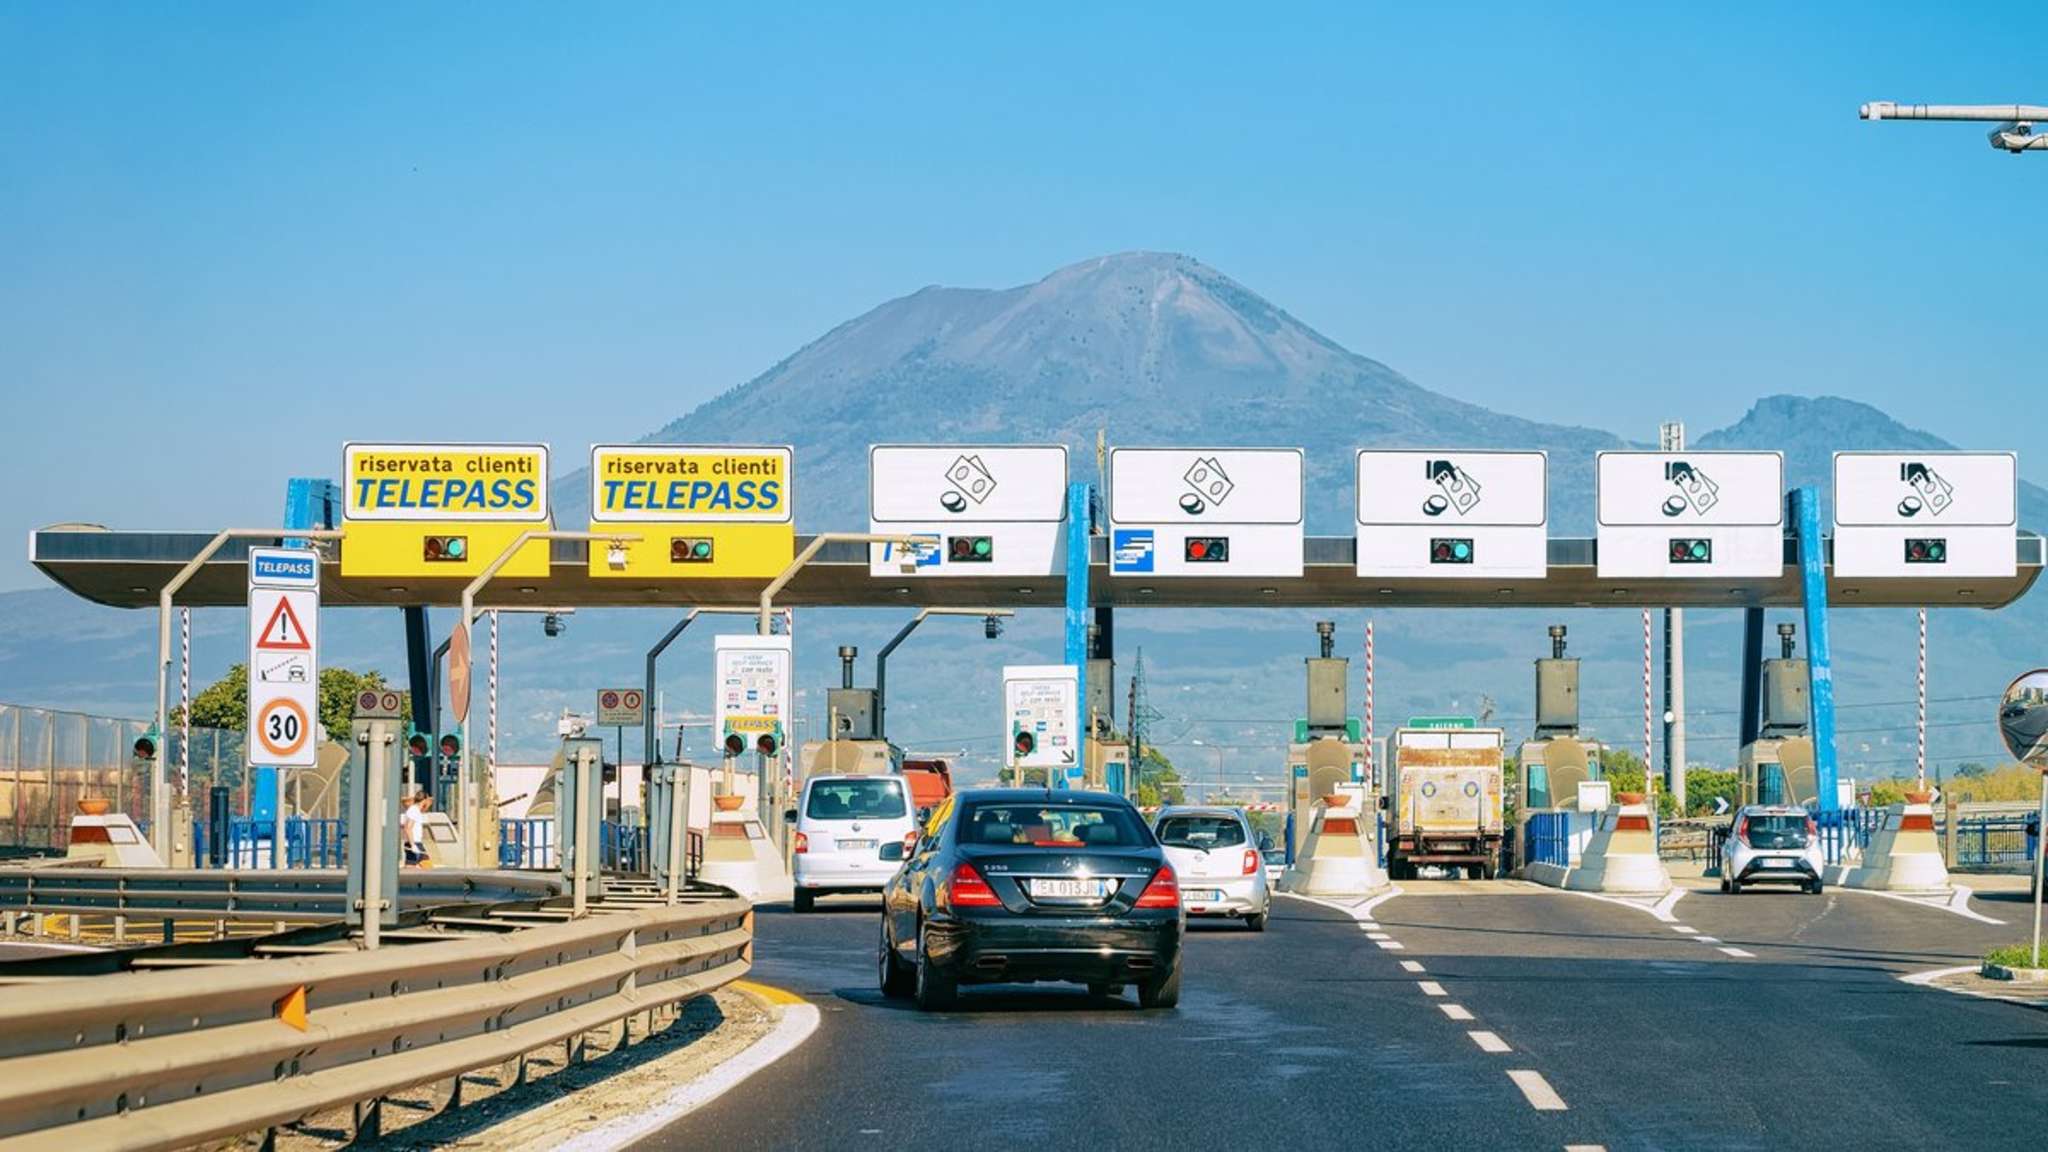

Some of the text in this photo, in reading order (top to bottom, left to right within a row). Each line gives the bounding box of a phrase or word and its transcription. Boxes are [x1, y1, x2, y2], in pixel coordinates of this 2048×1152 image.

[360, 456, 532, 473] riservata clienti
[607, 458, 776, 475] riservata clienti
[356, 479, 535, 509] TELEPASS
[604, 480, 780, 511] TELEPASS
[257, 561, 312, 574] TELEPASS
[269, 714, 298, 741] 30
